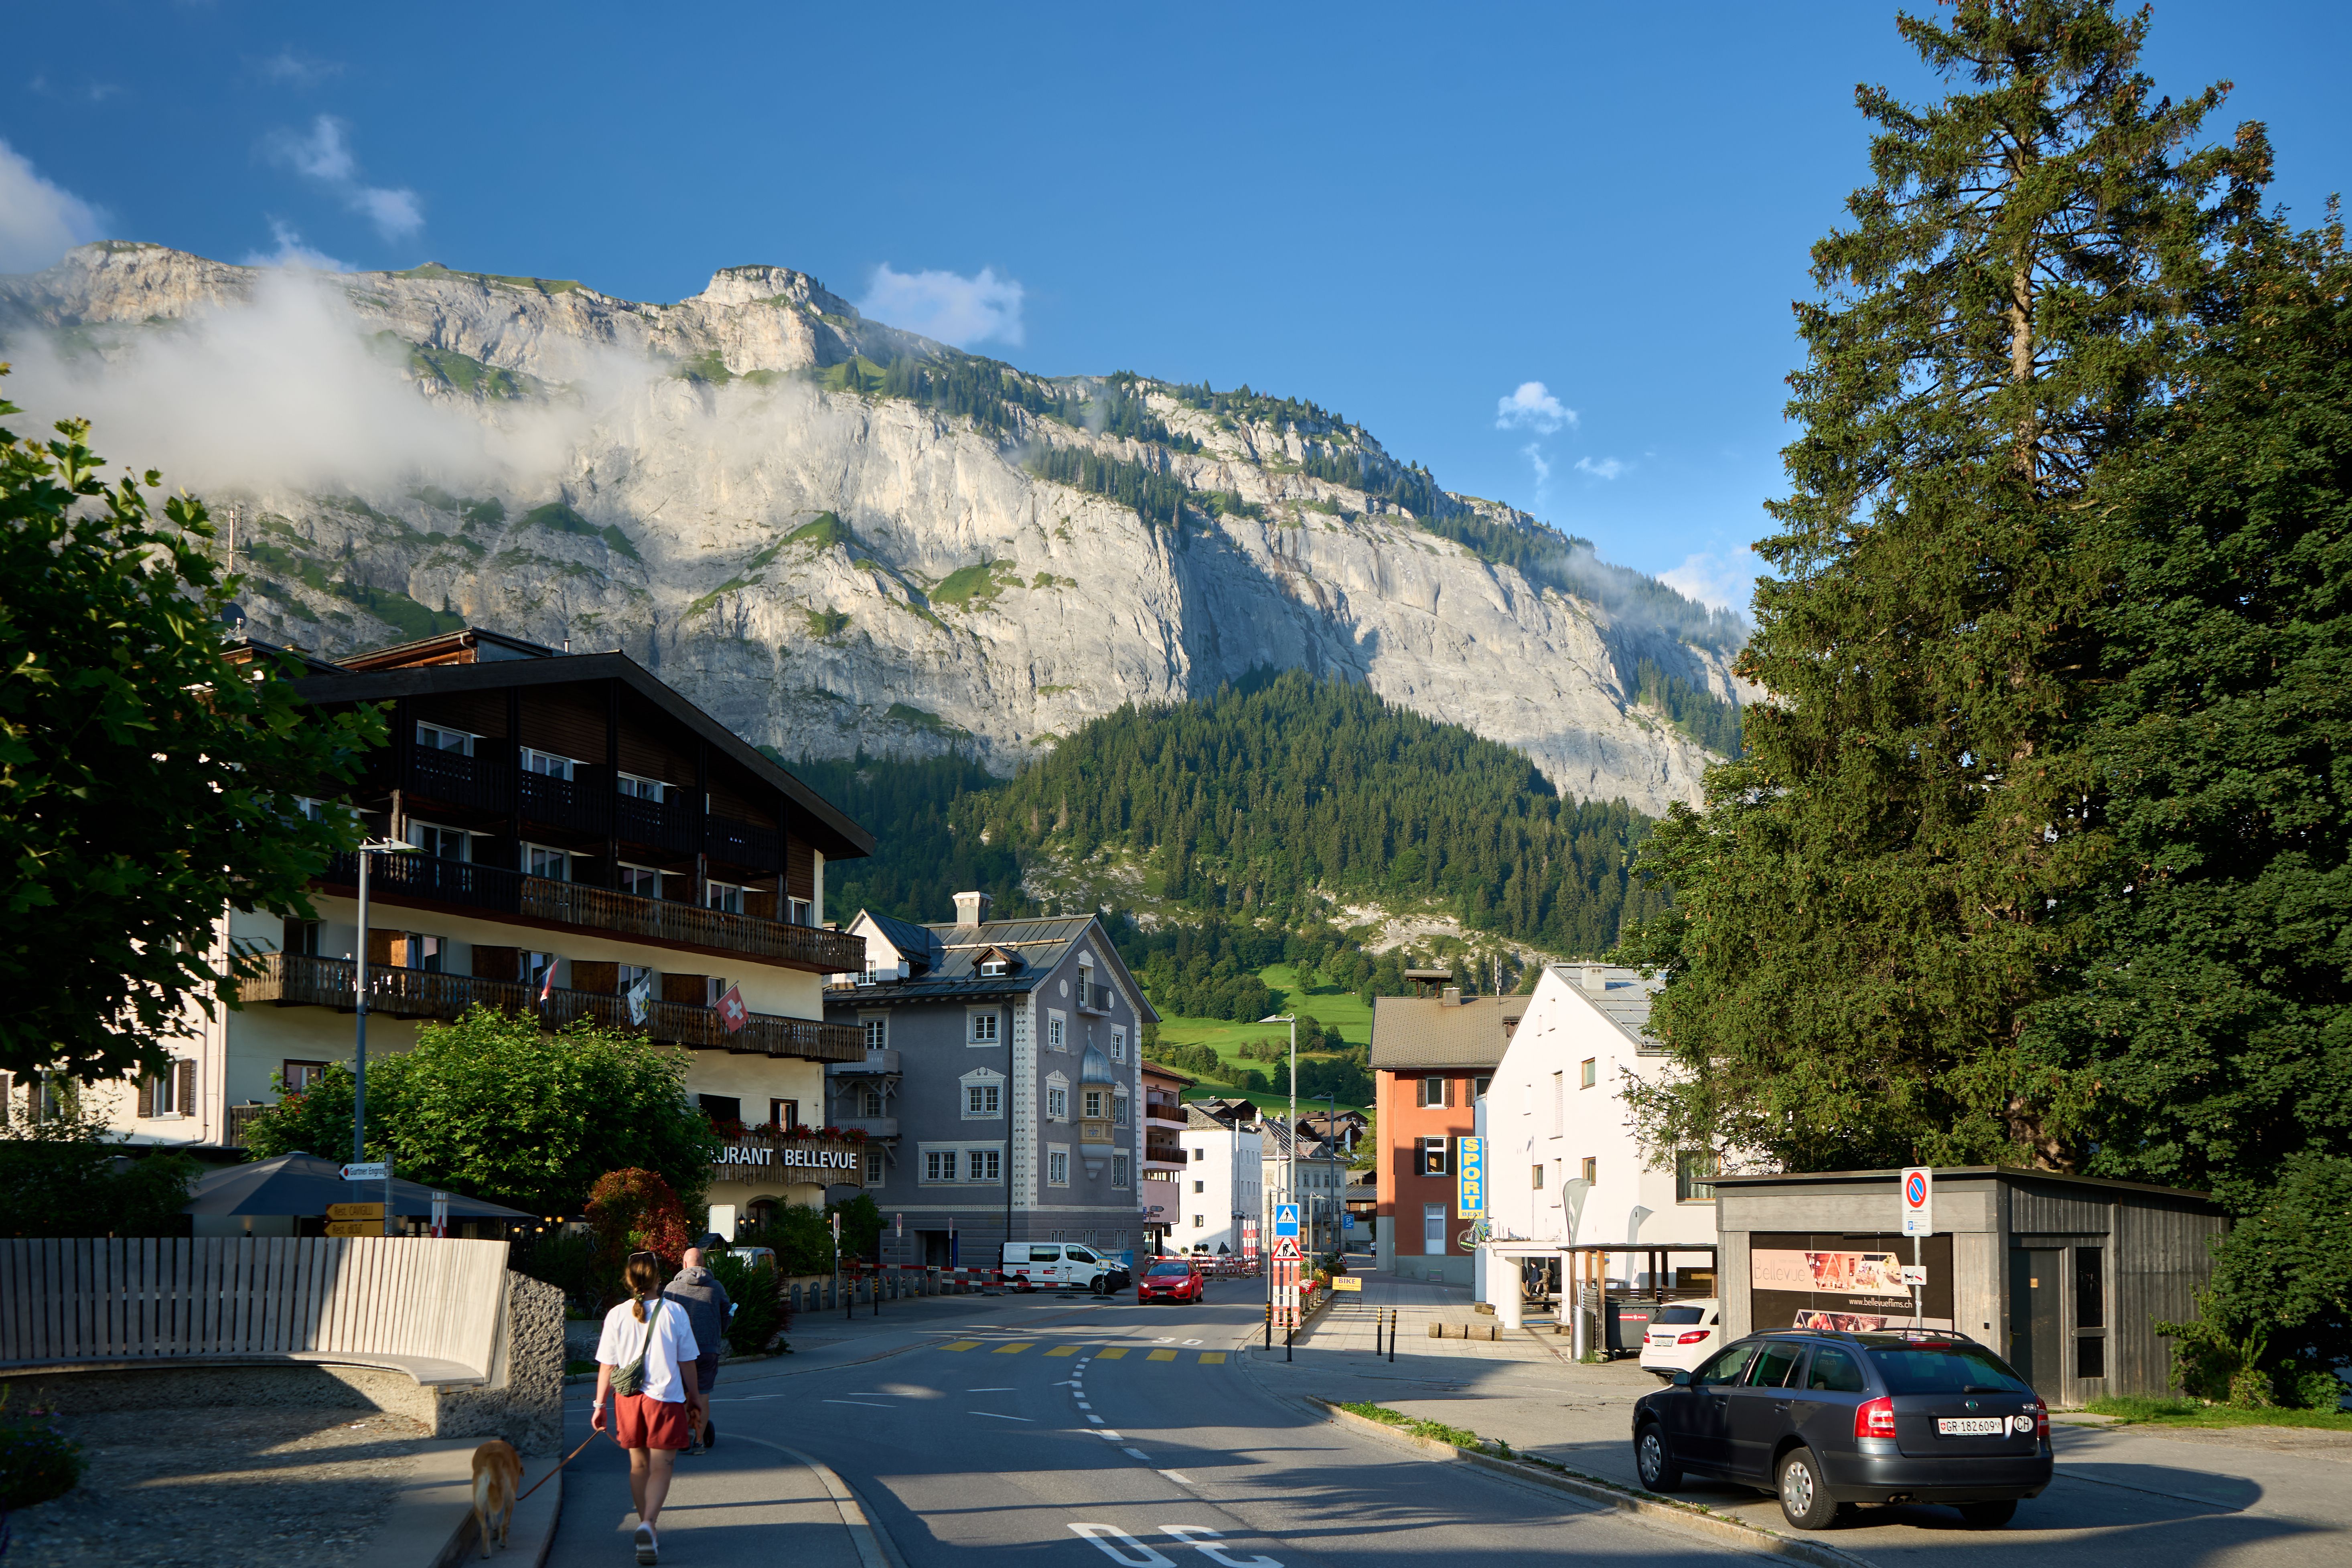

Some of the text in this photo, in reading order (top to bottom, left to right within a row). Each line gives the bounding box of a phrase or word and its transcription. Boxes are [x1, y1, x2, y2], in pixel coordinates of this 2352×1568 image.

[785, 1149, 857, 1169] BELLEVUE
[1463, 1139, 1480, 1208] SPORT
[335, 1206, 347, 1216] Rest.
[333, 1224, 345, 1234] Rest.
[1754, 1258, 1805, 1282] Bellevue
[1849, 1297, 1912, 1309] www.bellevueflims.ch
[1152, 1337, 1204, 1345] 30
[2017, 1418, 2029, 1430] CH
